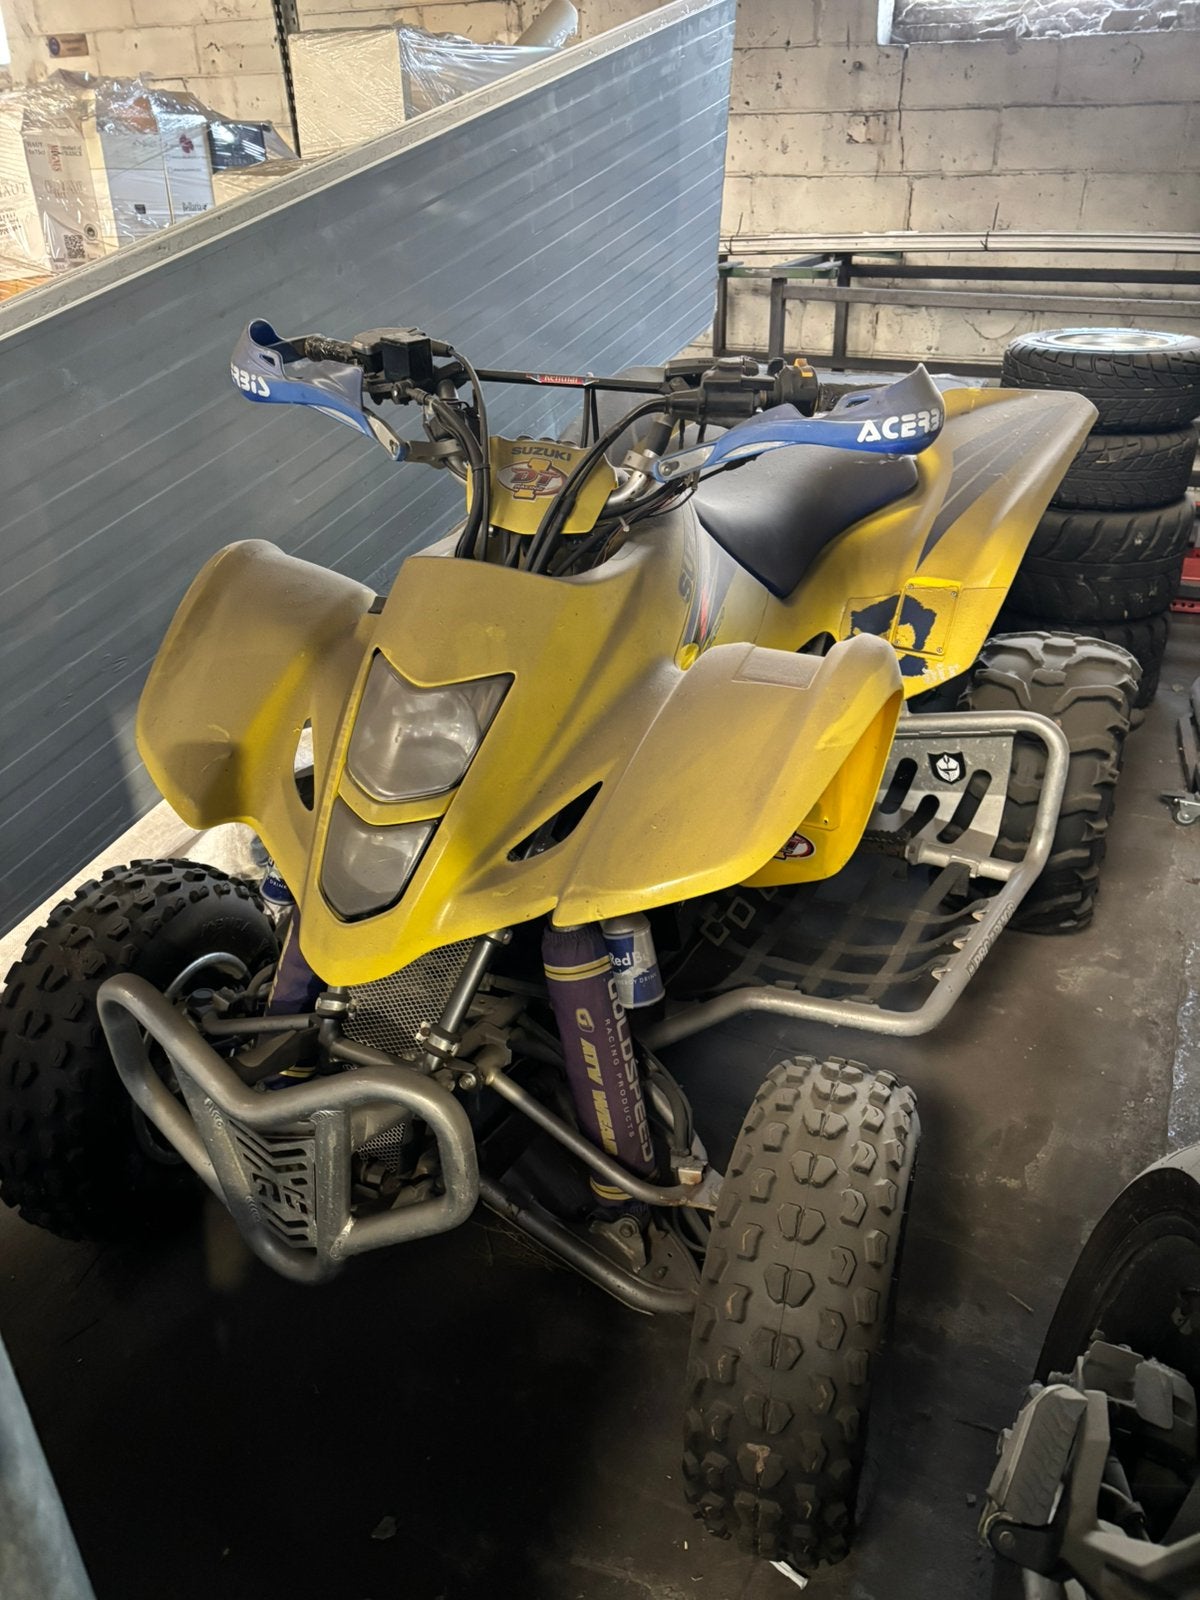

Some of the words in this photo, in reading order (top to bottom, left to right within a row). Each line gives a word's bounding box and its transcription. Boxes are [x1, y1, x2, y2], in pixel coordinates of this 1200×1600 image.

[856, 407, 942, 443] ACERB
[511, 446, 572, 462] SUZUKI
[579, 1037, 604, 1087] ATV
[604, 1018, 620, 1066] RACING
[616, 1072, 636, 1138] PRODUCTS
